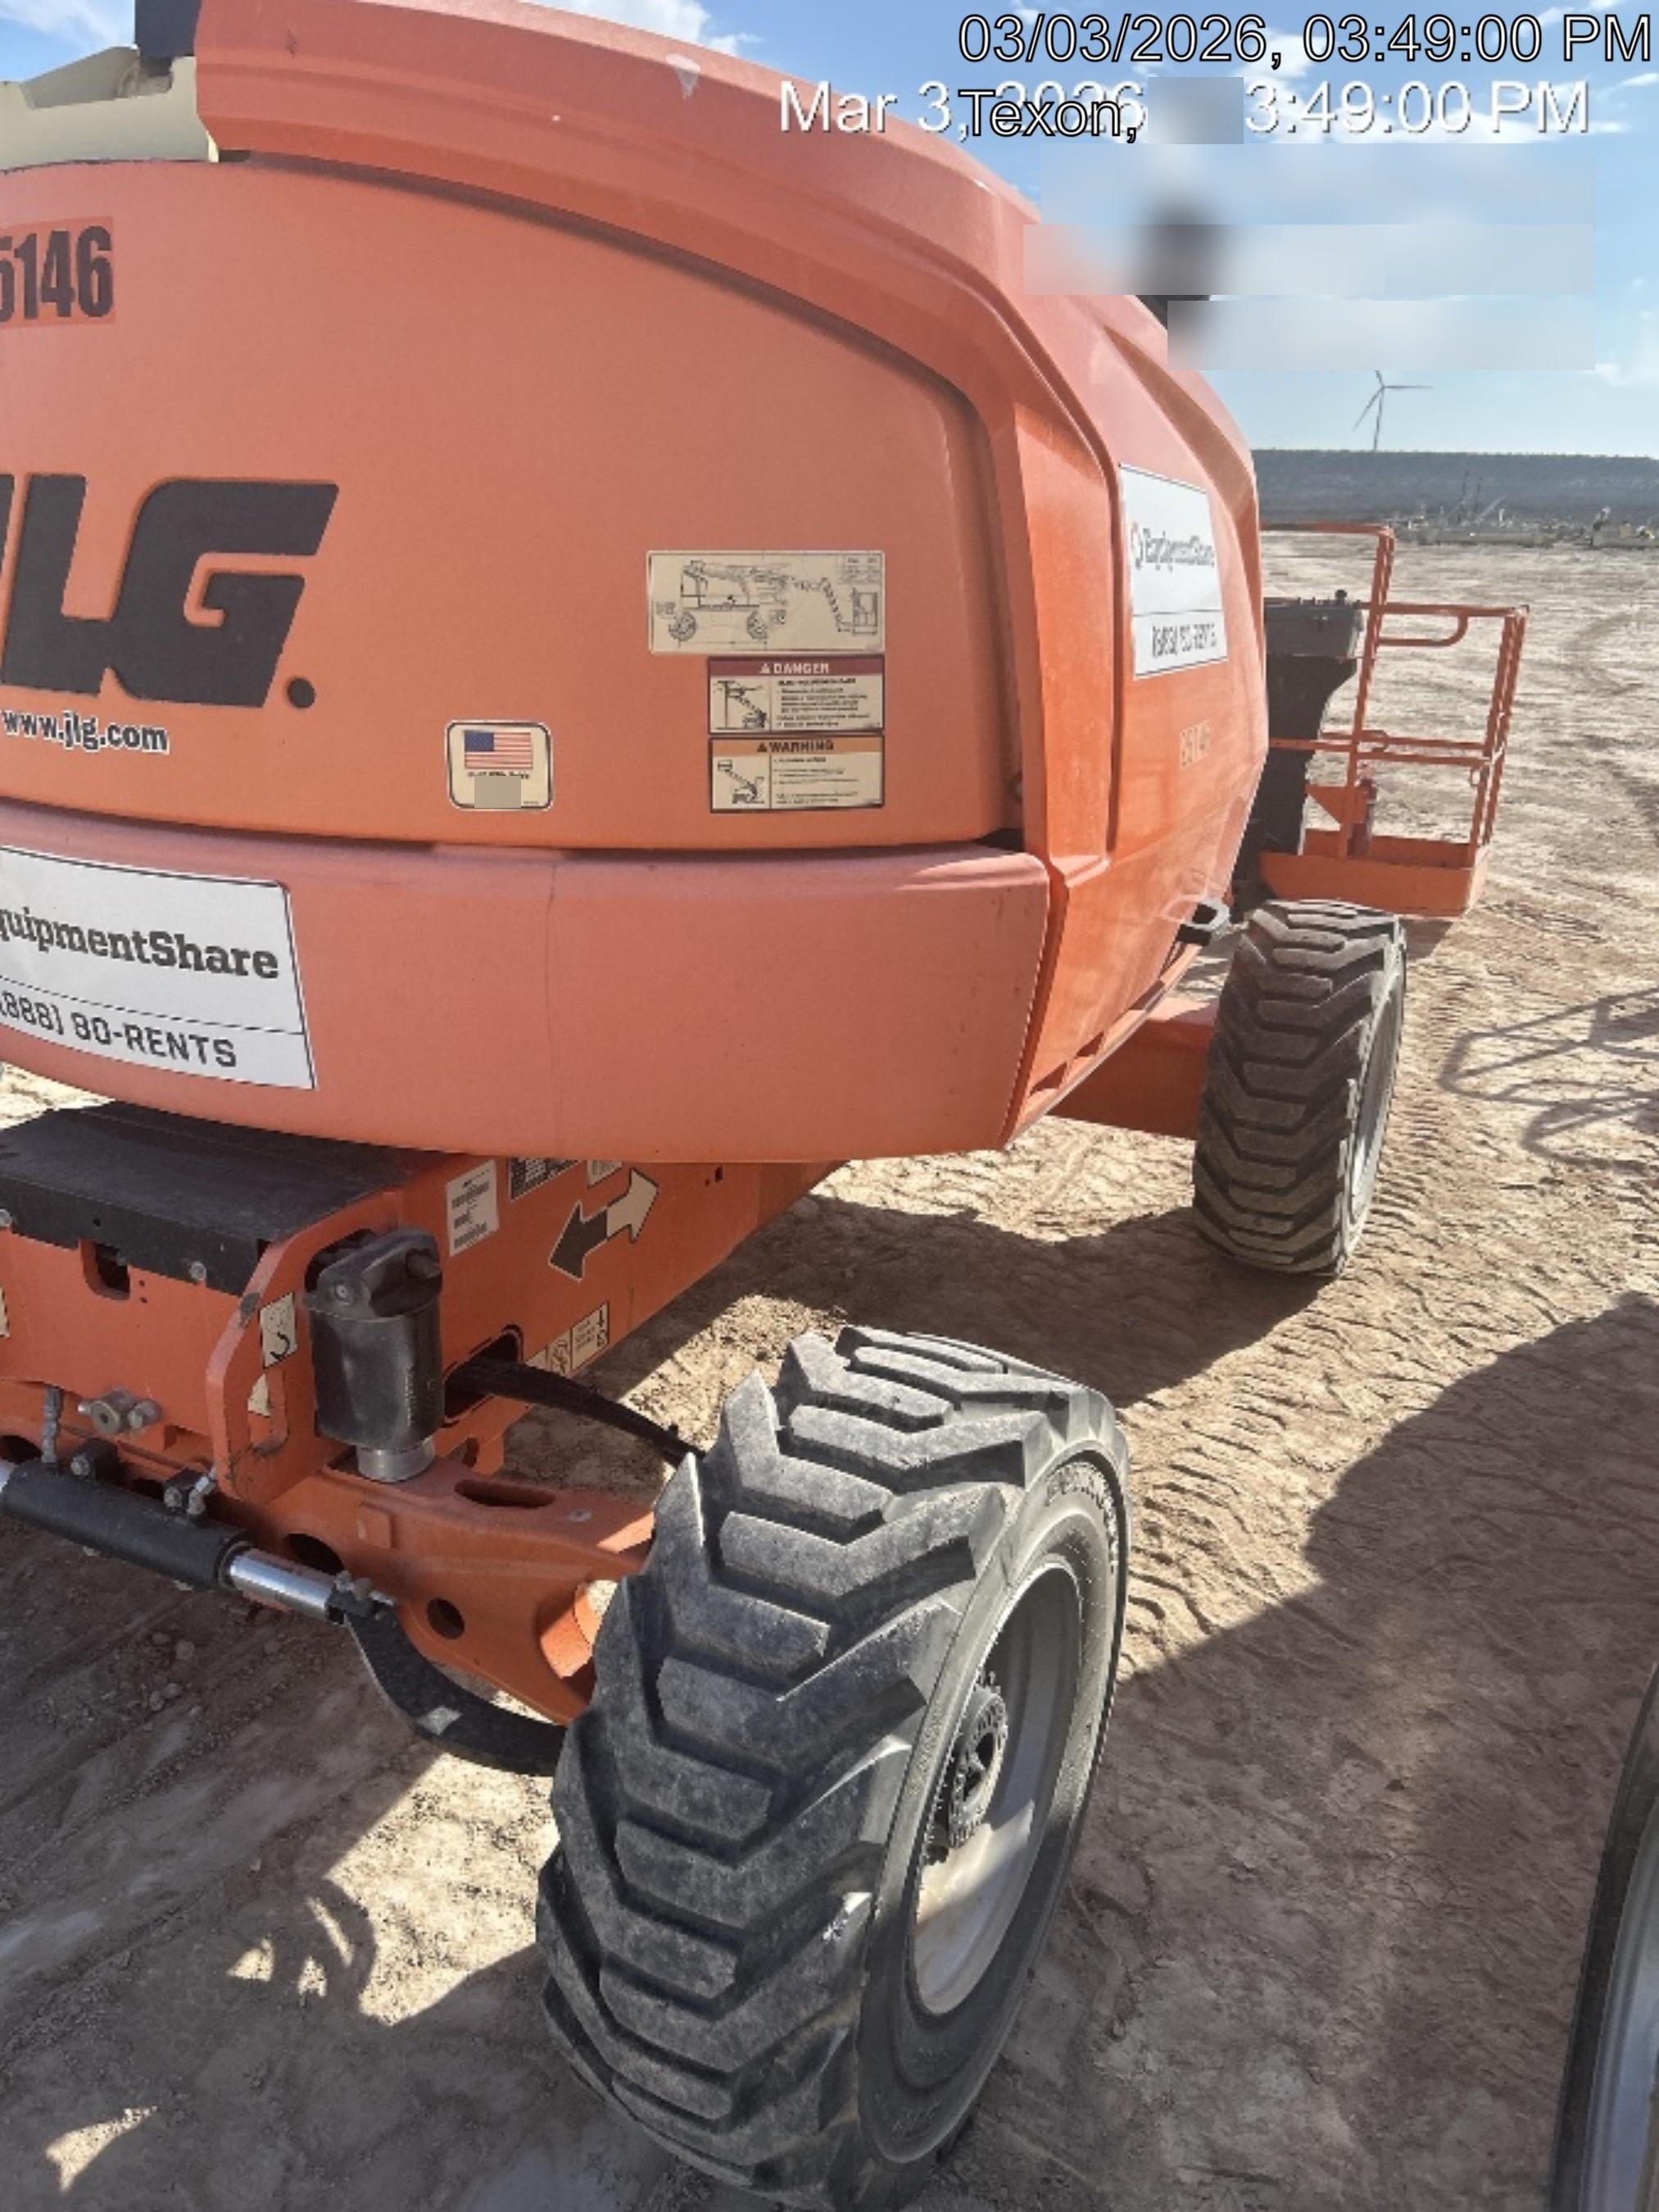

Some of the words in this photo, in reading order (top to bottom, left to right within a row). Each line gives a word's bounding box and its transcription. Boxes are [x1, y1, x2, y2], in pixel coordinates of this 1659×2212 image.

[773, 662, 830, 675] DANGER
[1, 709, 169, 753] www.jlg.com
[769, 740, 835, 753] WARNING
[70, 1011, 237, 1068] 80-RENTS
